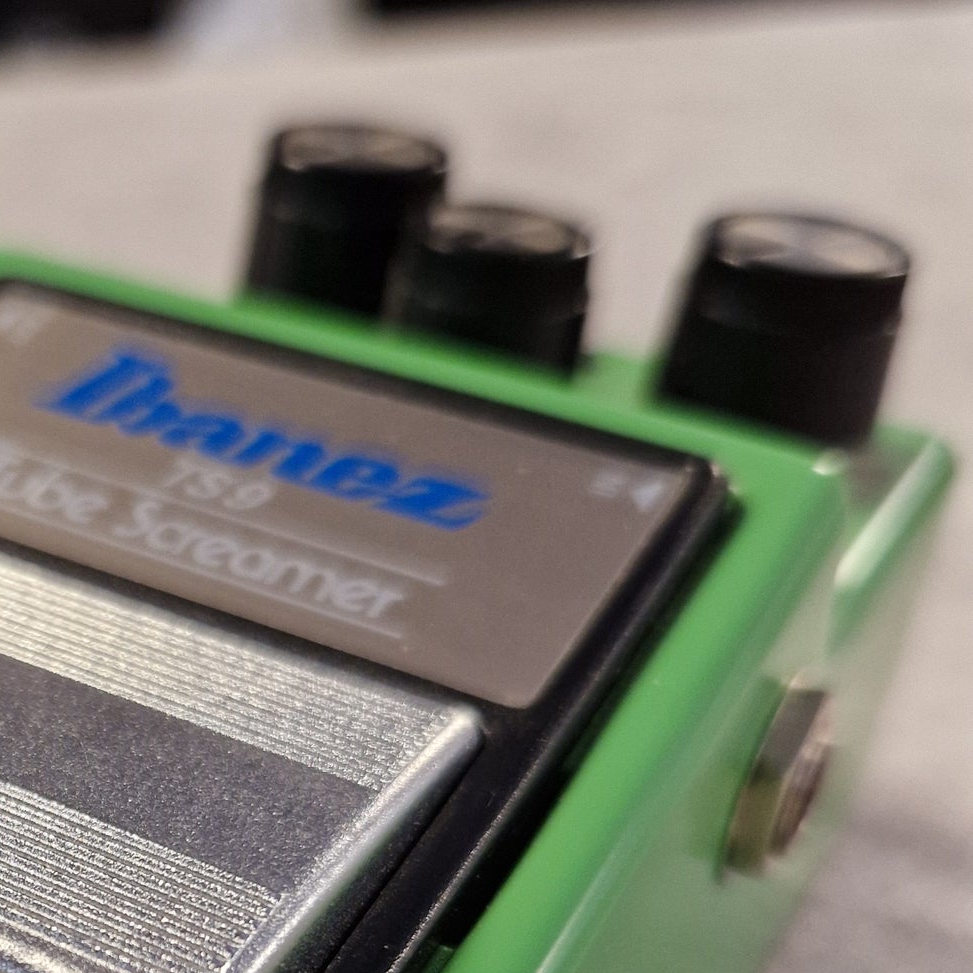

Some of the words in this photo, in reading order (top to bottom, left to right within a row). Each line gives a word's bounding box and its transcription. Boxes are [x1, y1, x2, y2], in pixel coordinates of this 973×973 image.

[43, 346, 488, 528] Ibanez
[164, 458, 273, 509] TS9
[114, 500, 405, 620] Screamer
